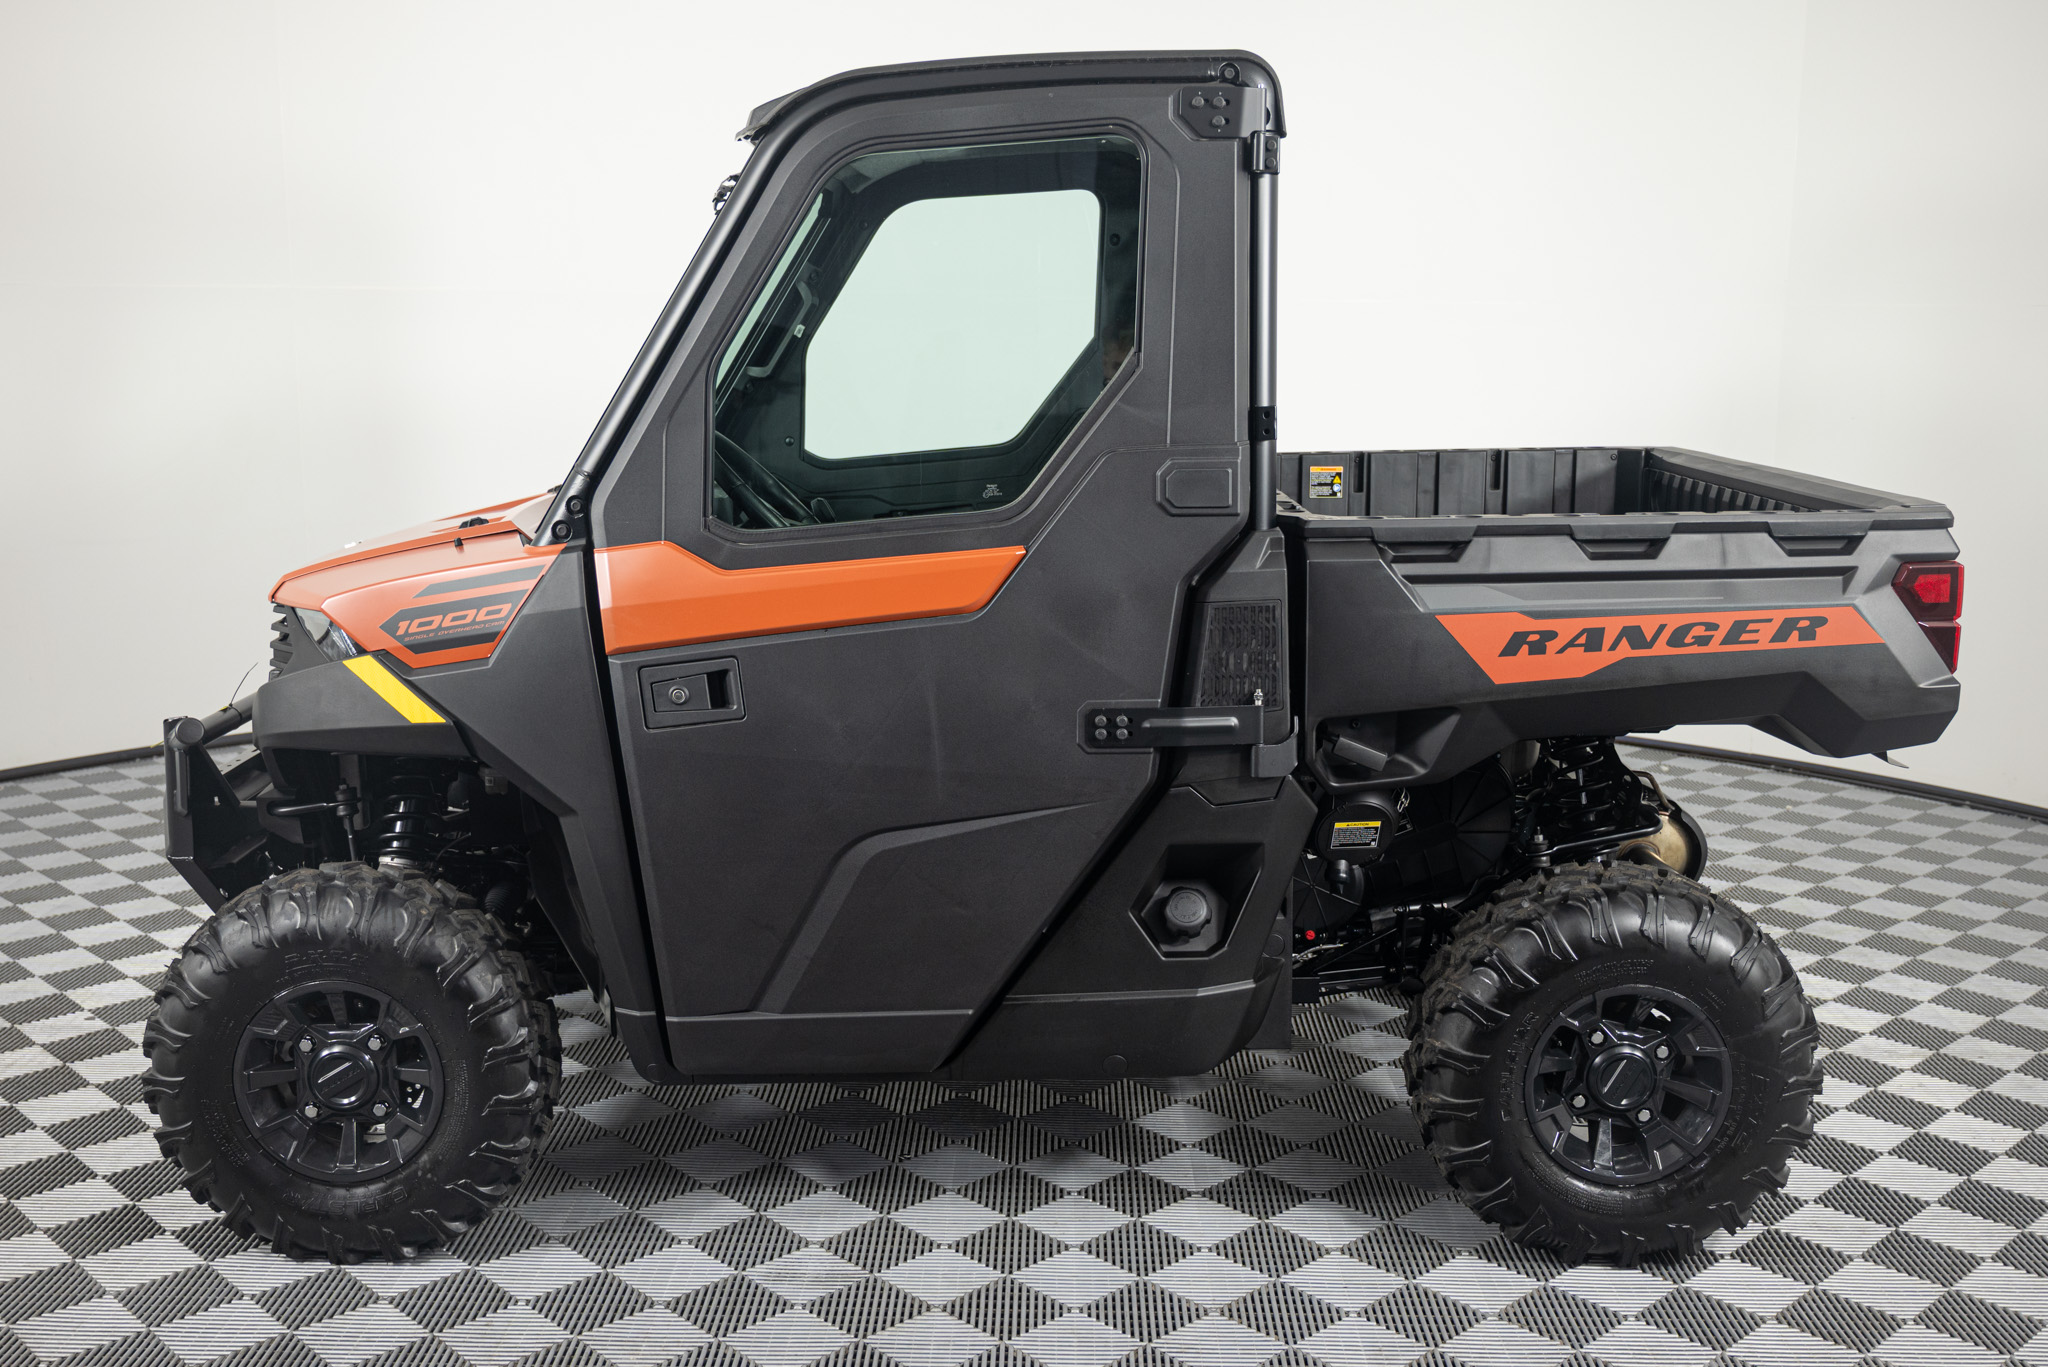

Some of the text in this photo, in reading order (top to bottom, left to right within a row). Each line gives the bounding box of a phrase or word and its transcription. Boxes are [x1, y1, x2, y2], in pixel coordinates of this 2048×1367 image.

[396, 603, 512, 636] 1000
[404, 620, 505, 642] SINGLE OVERHEAD CAM
[1498, 615, 1829, 657] RANGER
